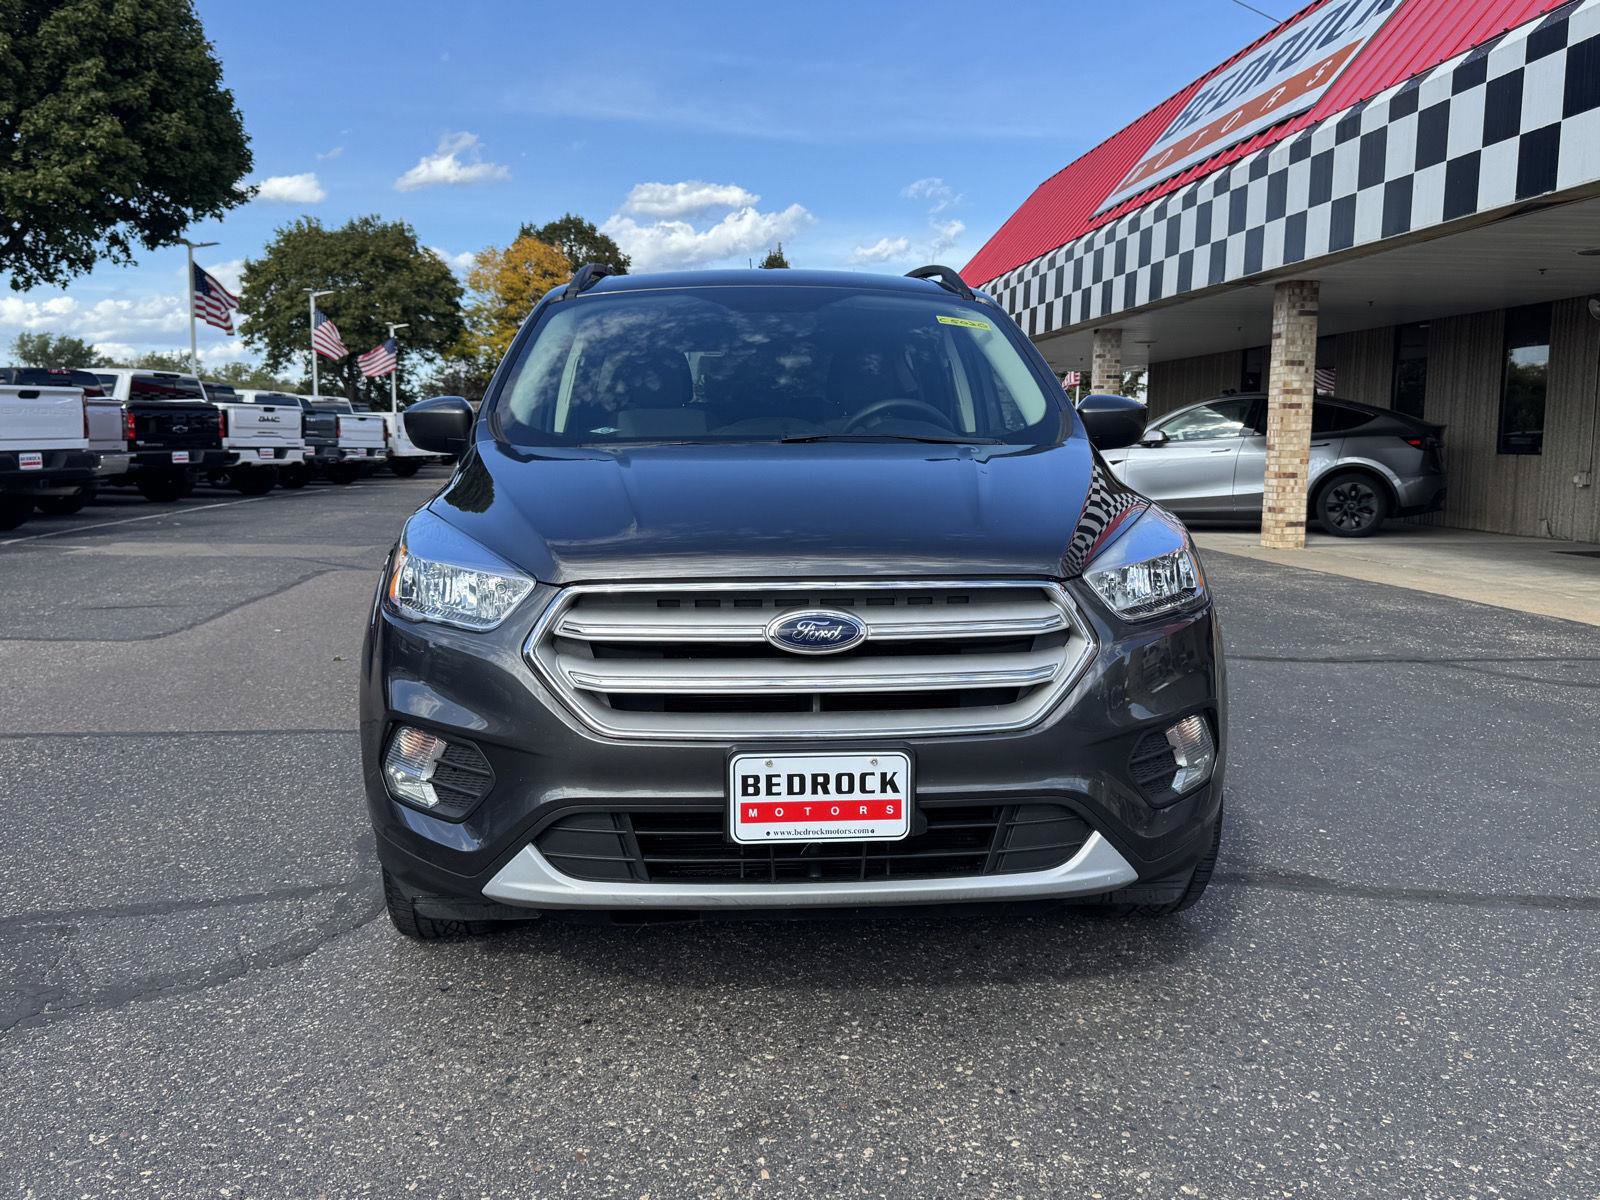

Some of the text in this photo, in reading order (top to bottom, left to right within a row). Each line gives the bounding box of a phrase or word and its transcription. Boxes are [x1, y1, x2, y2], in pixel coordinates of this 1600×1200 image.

[1124, 59, 1332, 185] MOTORS
[792, 620, 843, 640] Ford
[740, 771, 901, 797] BEDROCK
[748, 805, 894, 818] MOTORS
[773, 827, 870, 837] www.bedrockmotors.com
